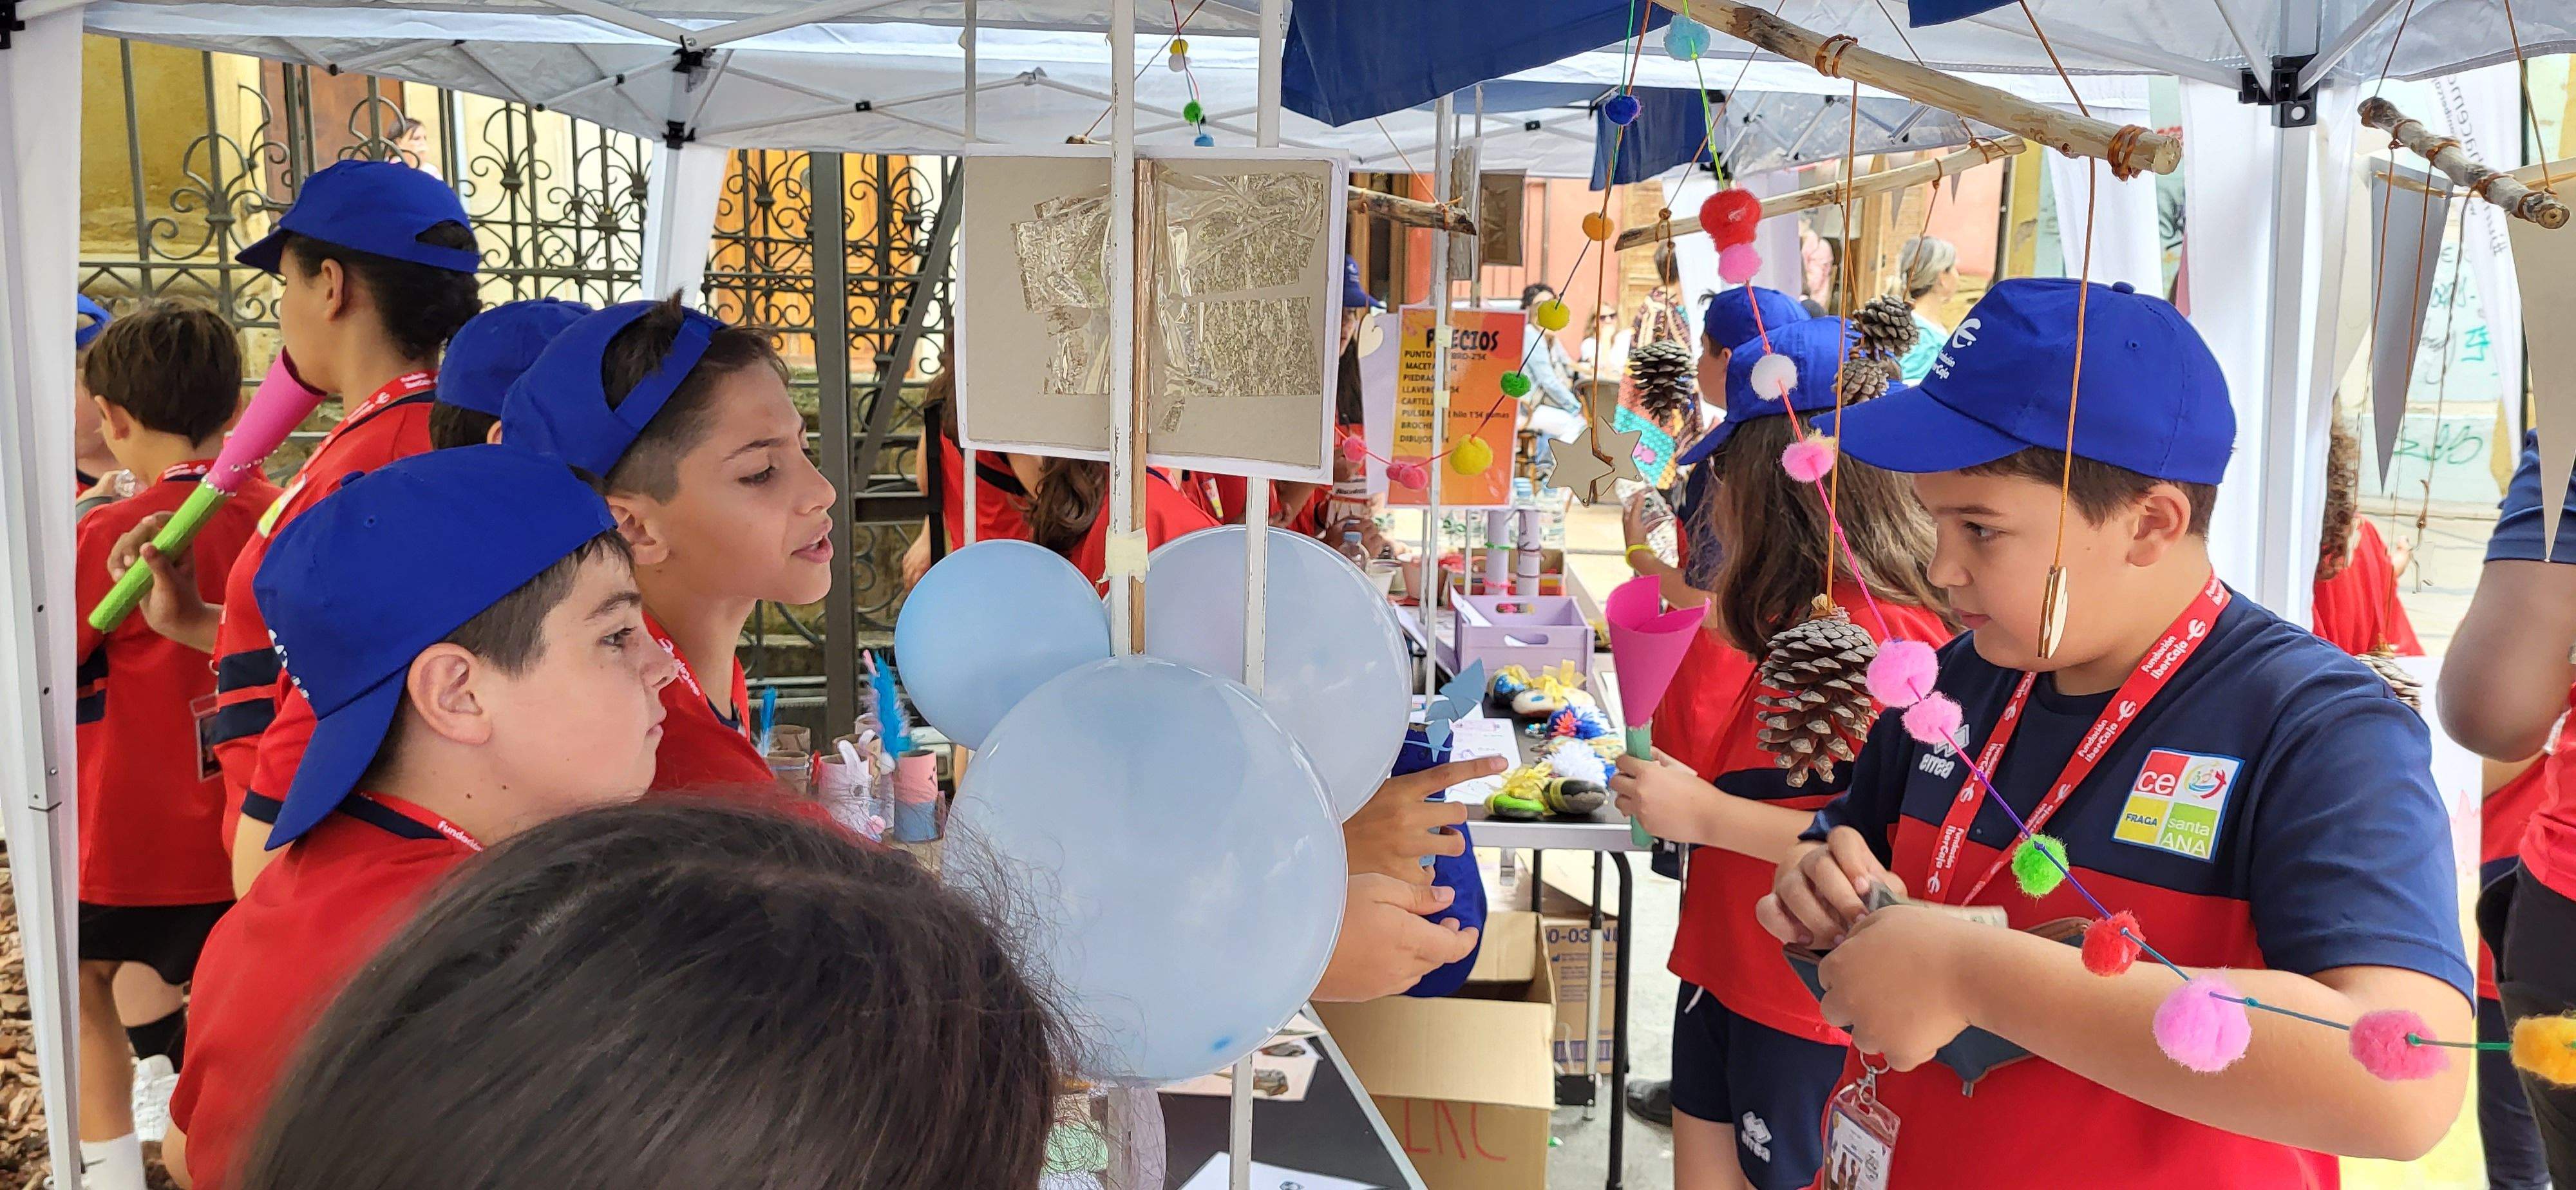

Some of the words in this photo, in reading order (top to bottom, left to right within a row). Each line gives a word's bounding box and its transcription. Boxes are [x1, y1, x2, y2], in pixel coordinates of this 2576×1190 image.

[1426, 328, 1499, 351] PECIOS
[1404, 350, 1432, 358] PUNTO
[2137, 771, 2176, 795] ce
[2126, 813, 2158, 827] FRAGA
[2168, 818, 2210, 836] santa
[2159, 832, 2206, 856] ANA
